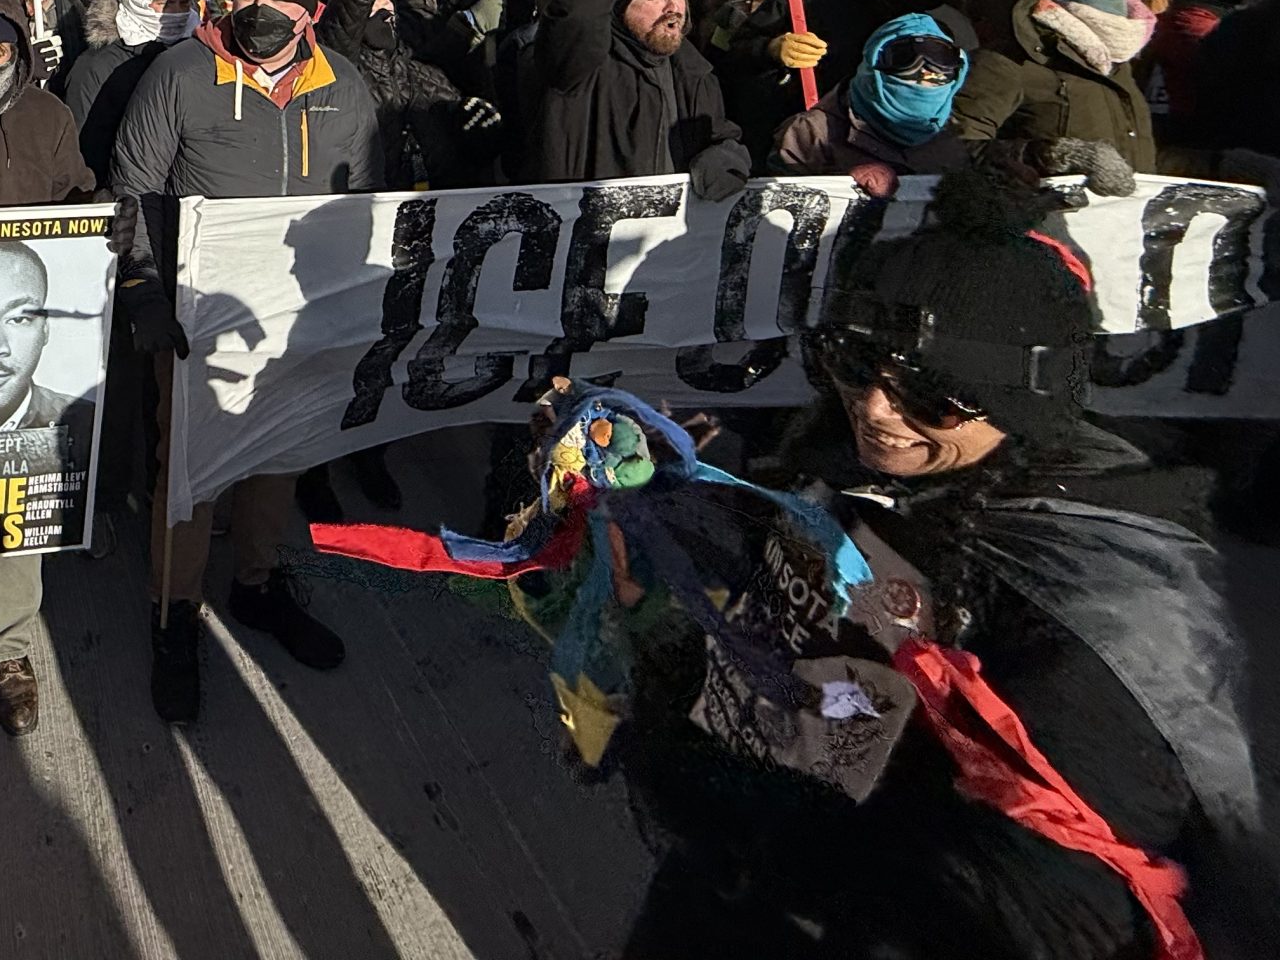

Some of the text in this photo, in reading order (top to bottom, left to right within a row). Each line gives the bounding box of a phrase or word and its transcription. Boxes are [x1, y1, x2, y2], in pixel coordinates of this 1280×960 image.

[3, 460, 28, 475] ALA
[66, 471, 86, 482] LEVY
[28, 482, 80, 495] ARMSTRONG
[25, 510, 52, 520] ALLEN
[25, 525, 62, 537] WILLIAM
[24, 536, 48, 547] KELLY
